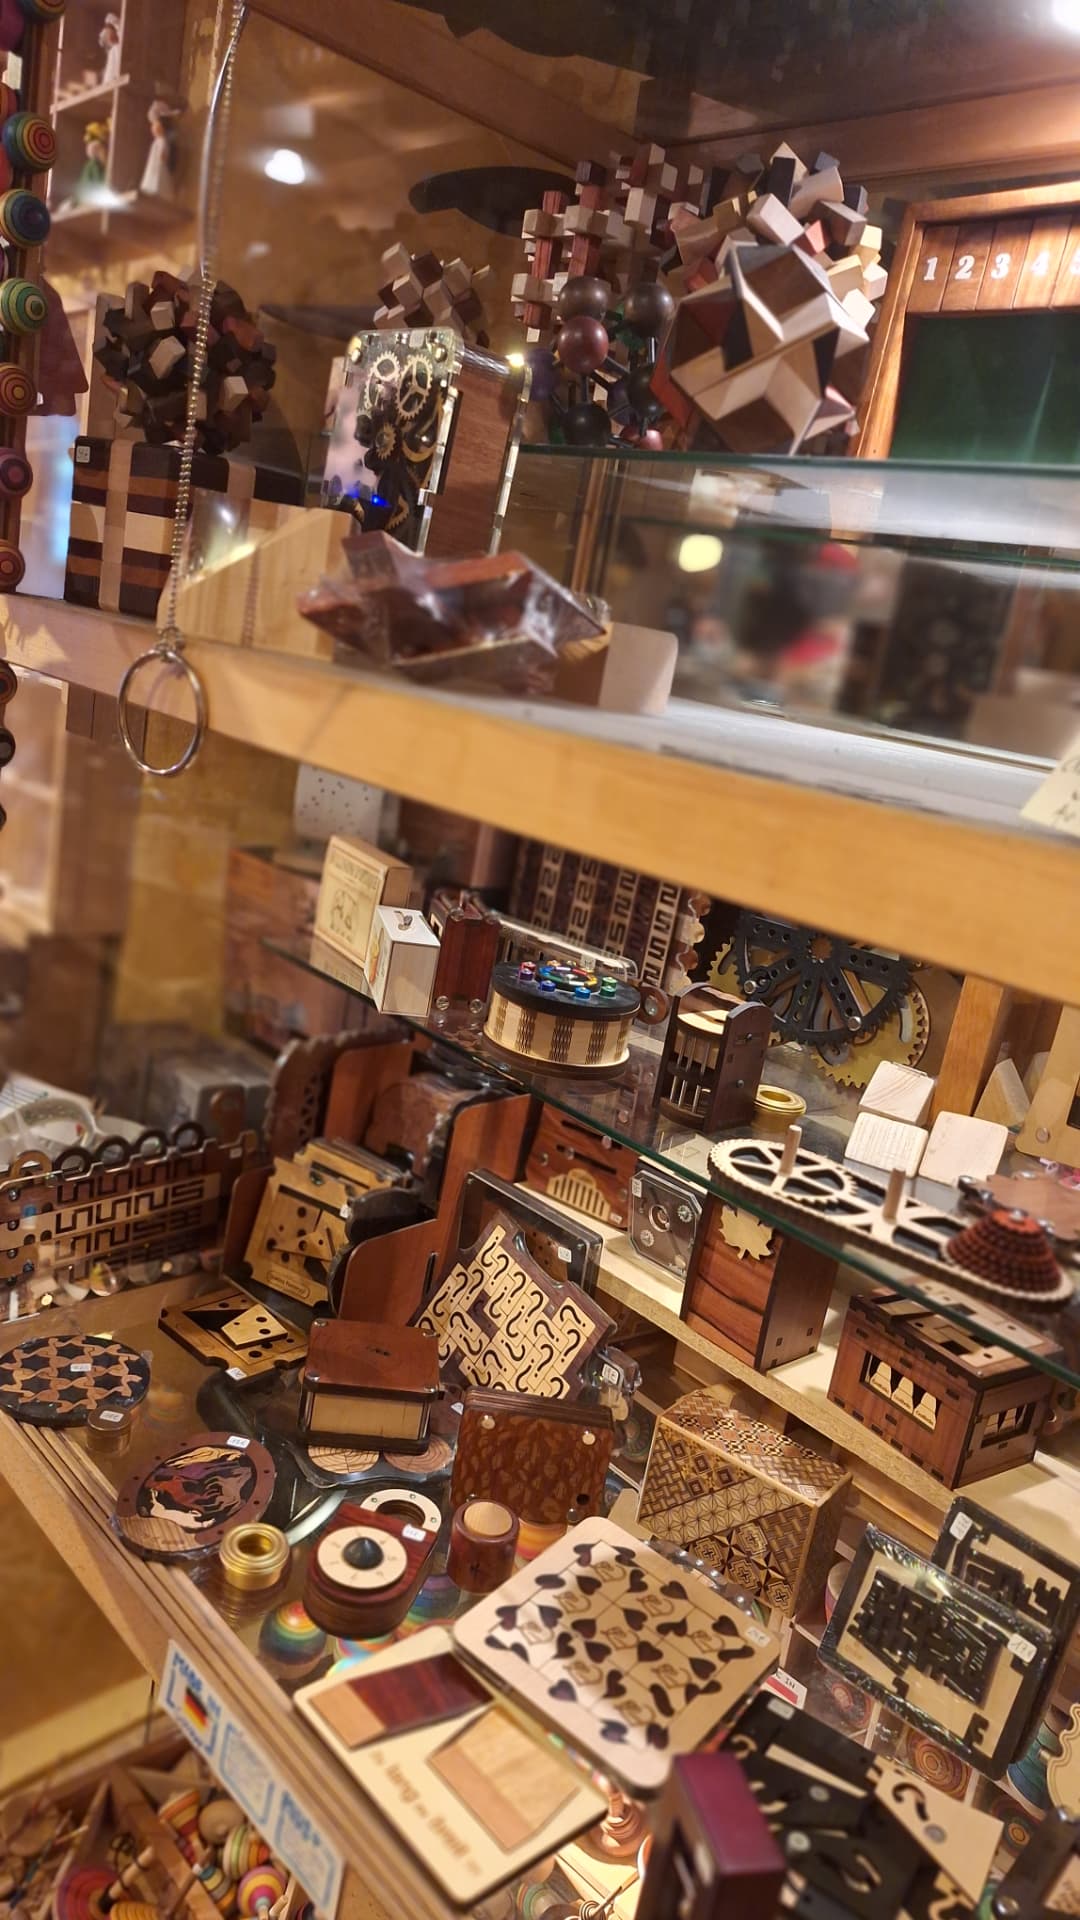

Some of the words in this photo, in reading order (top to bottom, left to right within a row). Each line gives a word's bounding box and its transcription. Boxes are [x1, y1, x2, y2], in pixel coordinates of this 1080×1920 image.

[923, 256, 938, 281] 1
[955, 254, 975, 280] 2
[991, 253, 1011, 279] 3
[1030, 250, 1050, 277] 4
